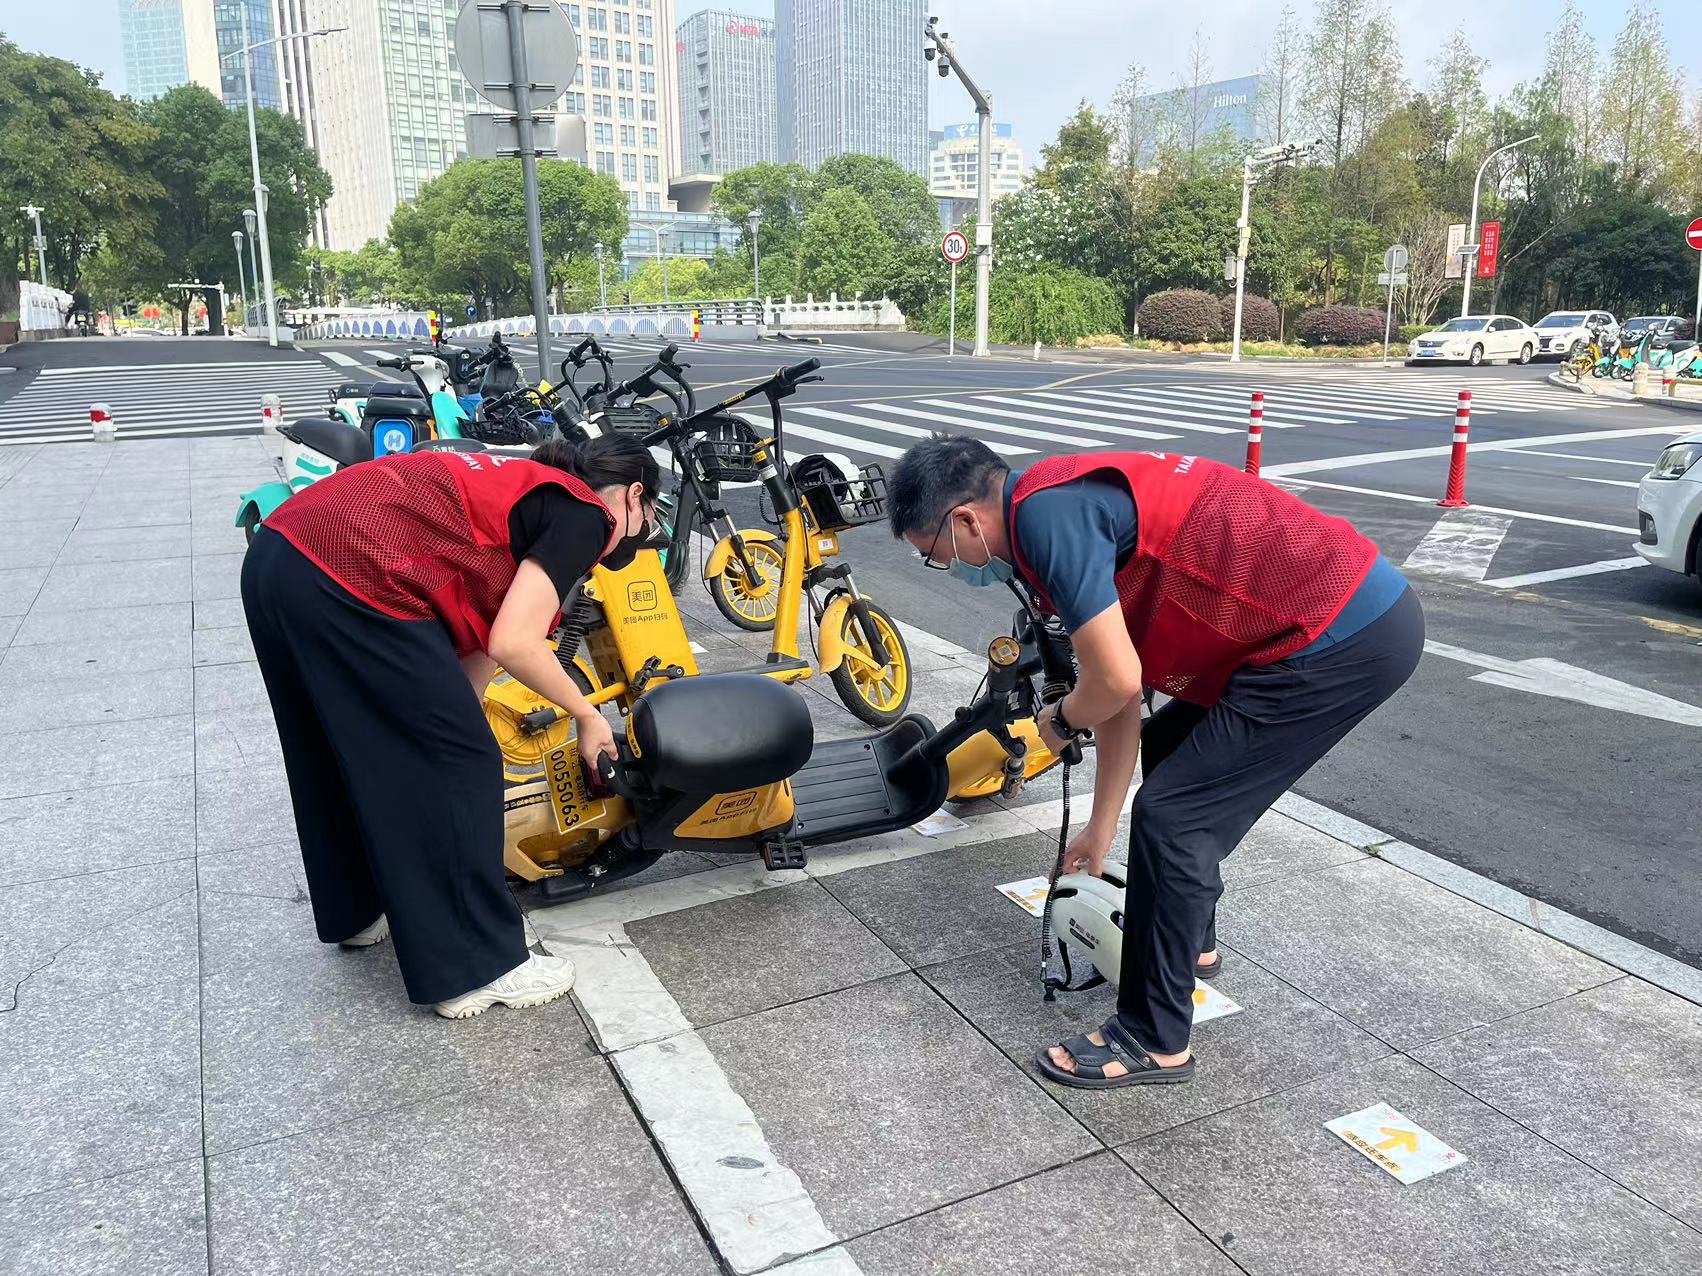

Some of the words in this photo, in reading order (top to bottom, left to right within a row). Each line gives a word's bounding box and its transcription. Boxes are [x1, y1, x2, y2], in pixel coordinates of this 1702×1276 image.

[1213, 94, 1247, 108] Hilton
[632, 590, 654, 602] 美团
[550, 750, 580, 827] 0055063
